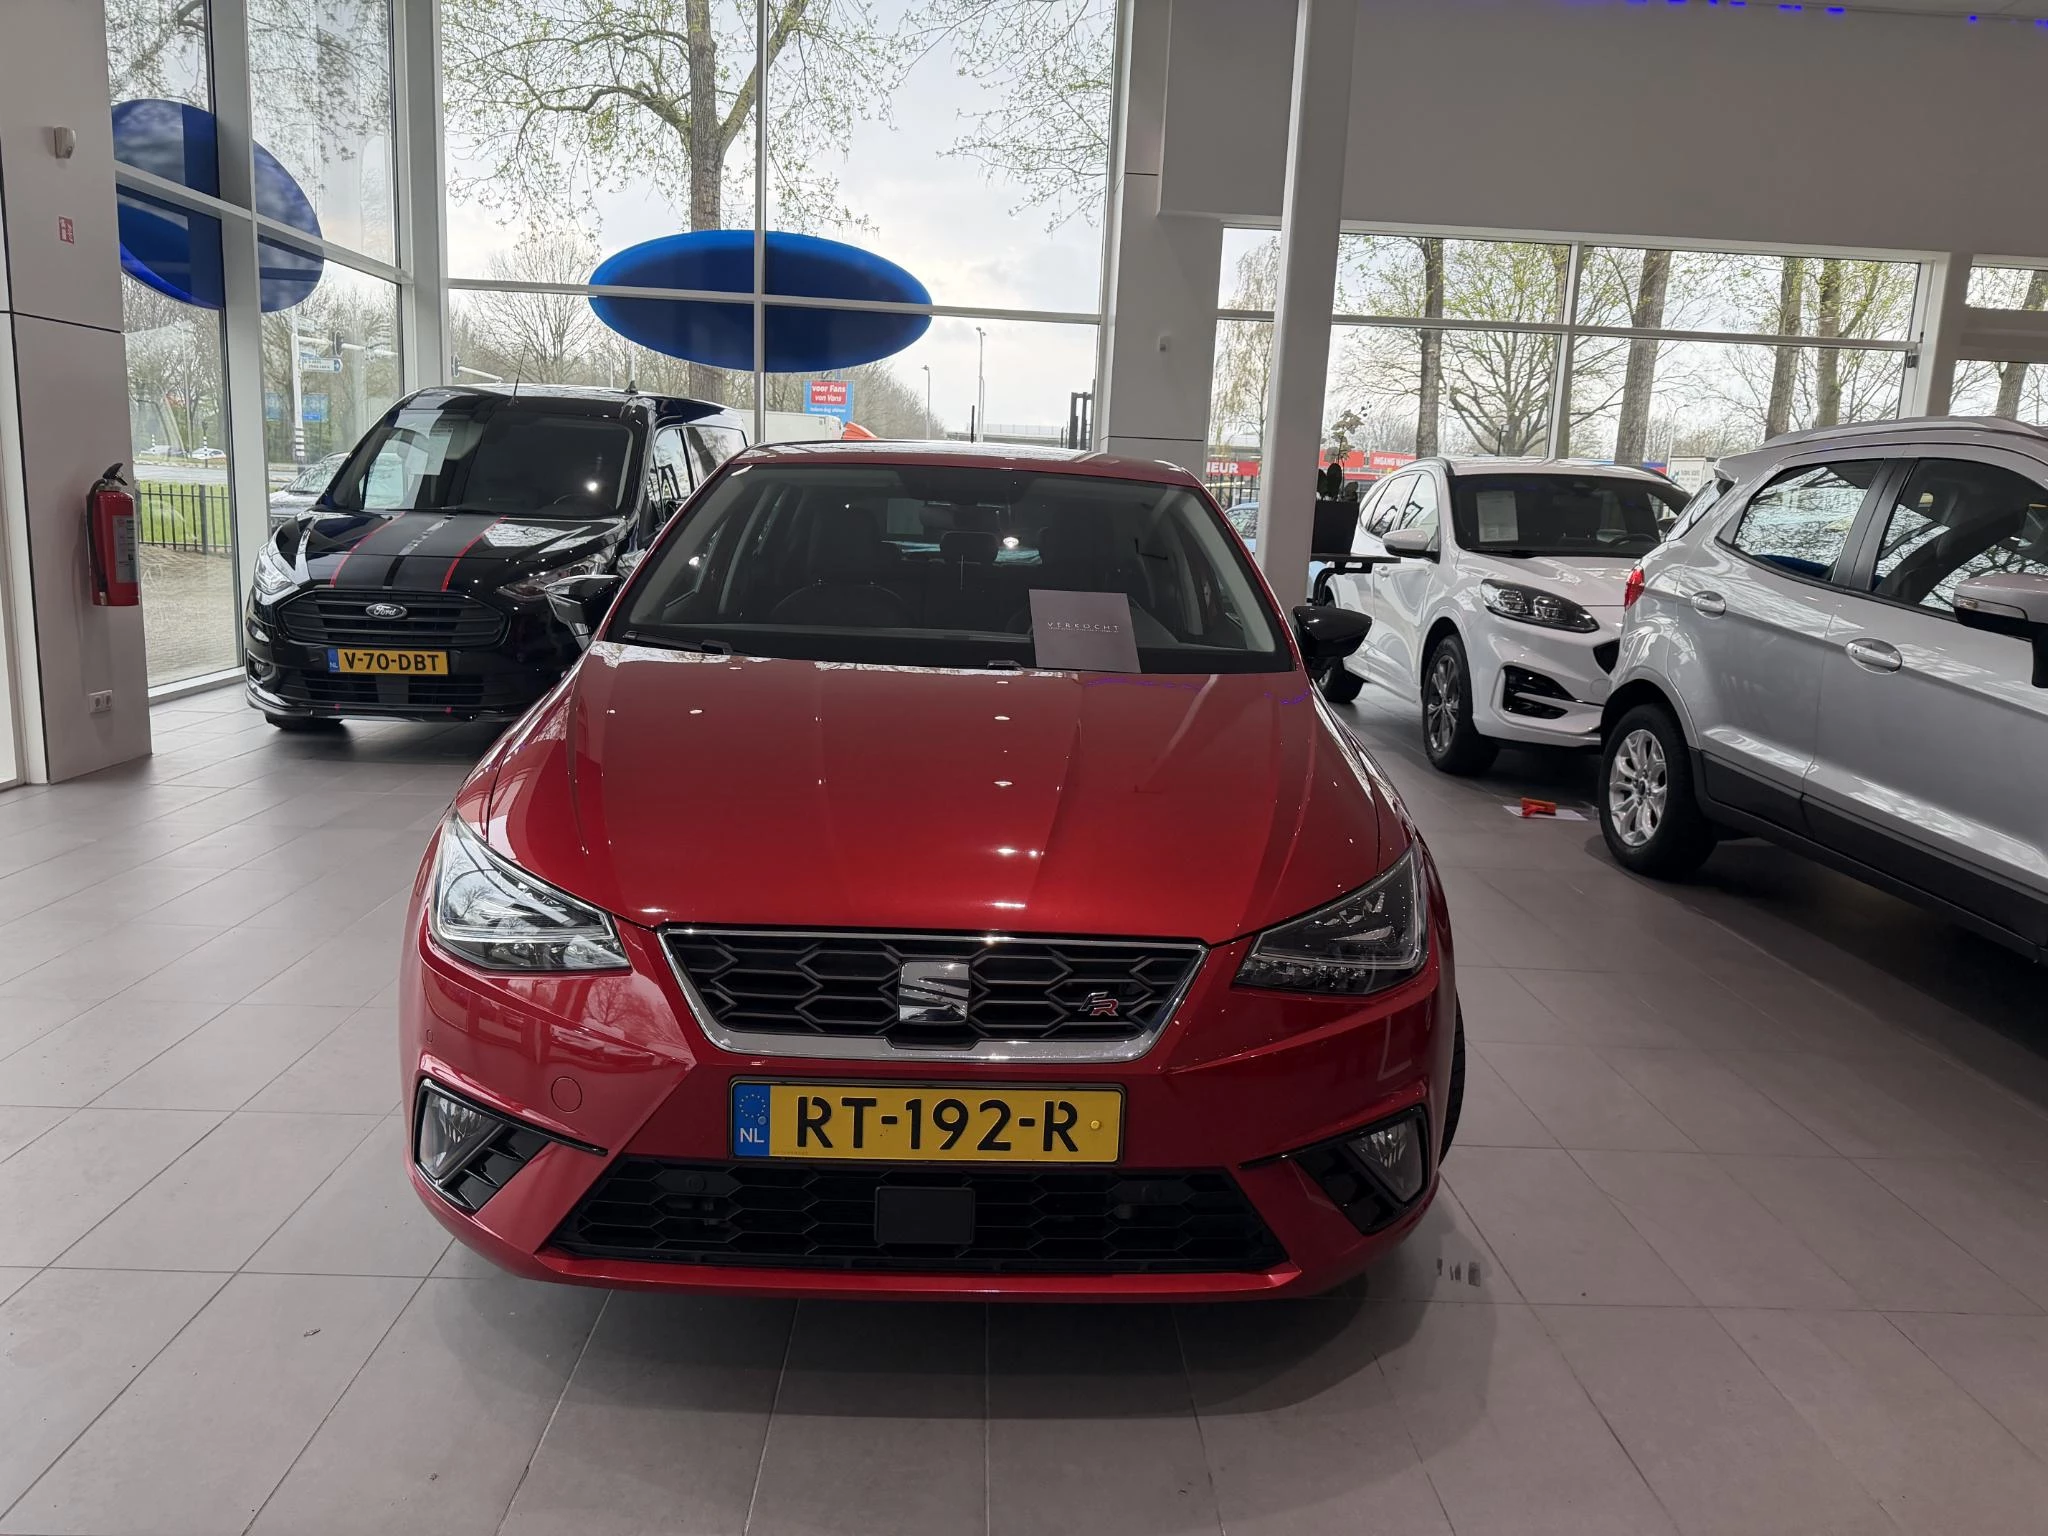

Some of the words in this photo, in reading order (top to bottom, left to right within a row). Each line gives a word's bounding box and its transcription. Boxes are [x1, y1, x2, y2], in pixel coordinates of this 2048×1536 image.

[829, 384, 846, 393] Fans
[373, 603, 397, 616] Ford
[1047, 621, 1119, 631] VERKOCHT
[344, 652, 439, 671] V-70-DBT
[740, 1127, 765, 1143] NL
[796, 1096, 1079, 1153] RT-192-R
